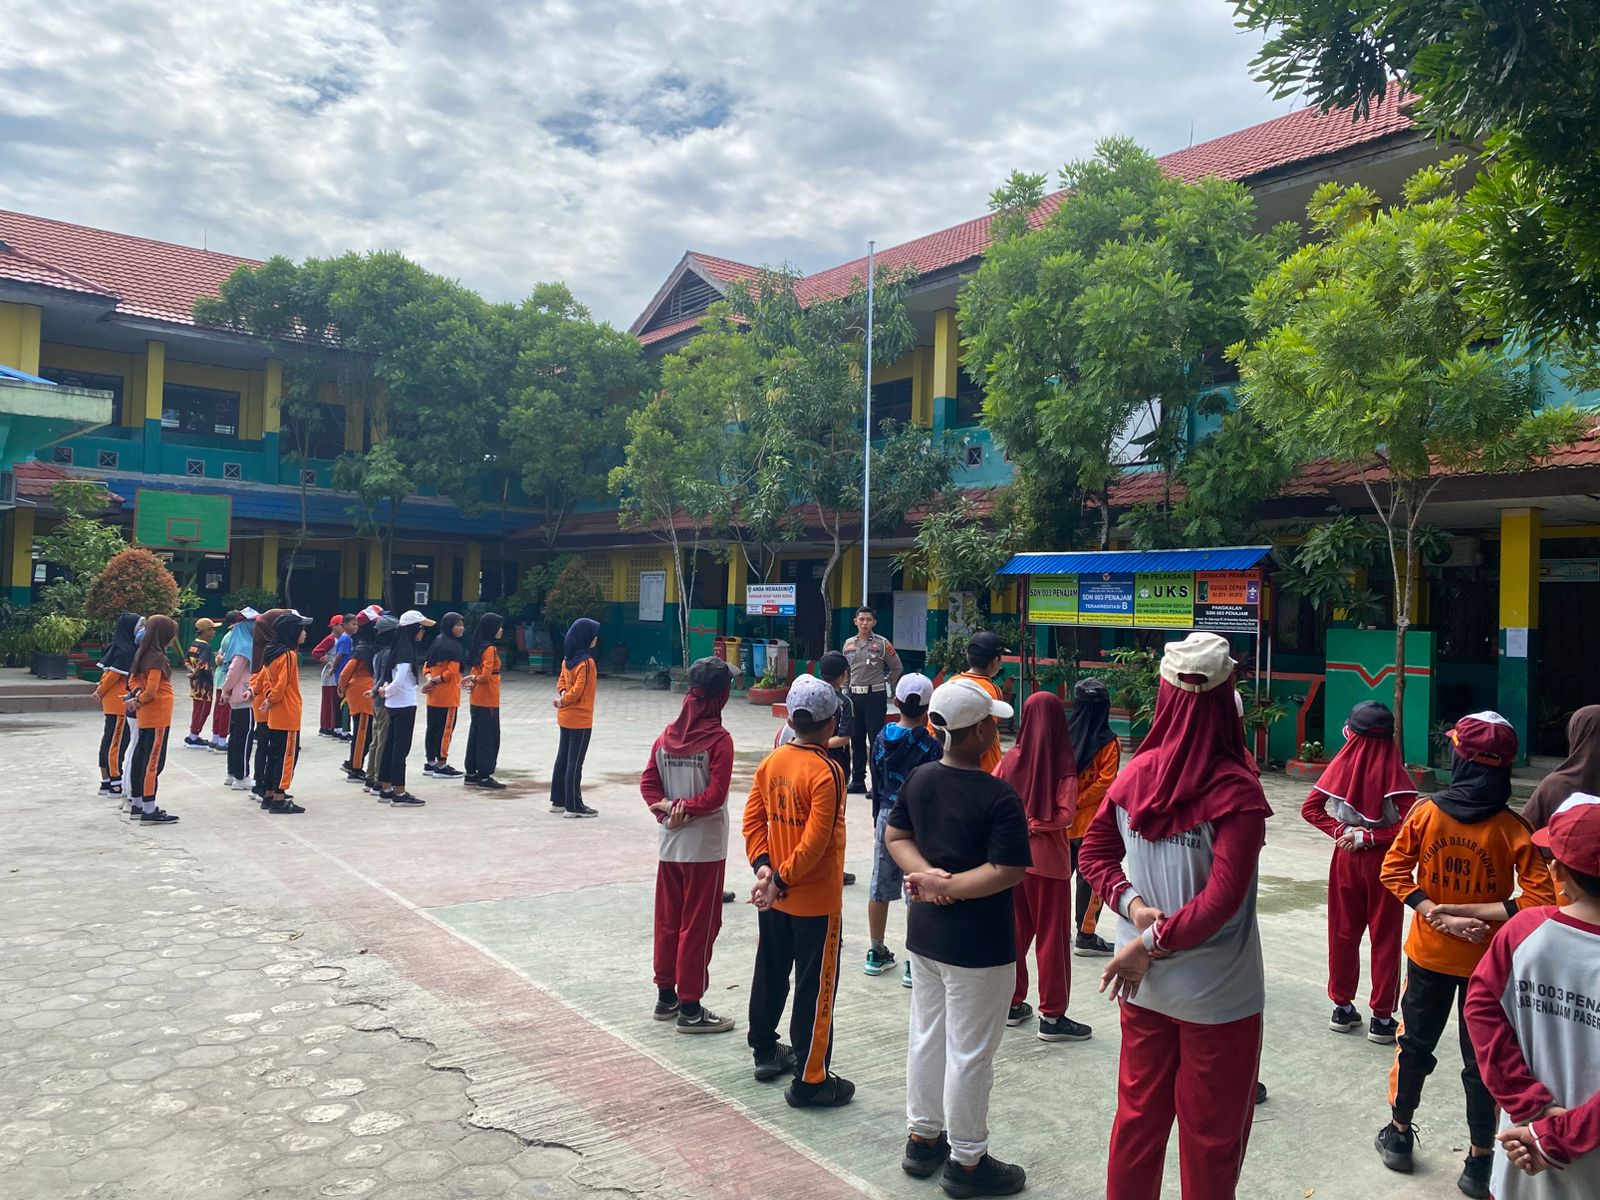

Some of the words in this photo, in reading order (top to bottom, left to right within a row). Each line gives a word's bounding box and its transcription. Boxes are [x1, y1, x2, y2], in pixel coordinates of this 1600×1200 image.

[1030, 588, 1041, 597] SDN
[1042, 588, 1052, 597] 003
[1053, 588, 1078, 597] PENAJAM
[1154, 584, 1189, 598] UKS
[1121, 601, 1128, 610] B
[1449, 836, 1478, 852] DASAR
[1445, 856, 1471, 876] 003
[1514, 980, 1535, 994] SDN
[1537, 983, 1564, 1001] 003
